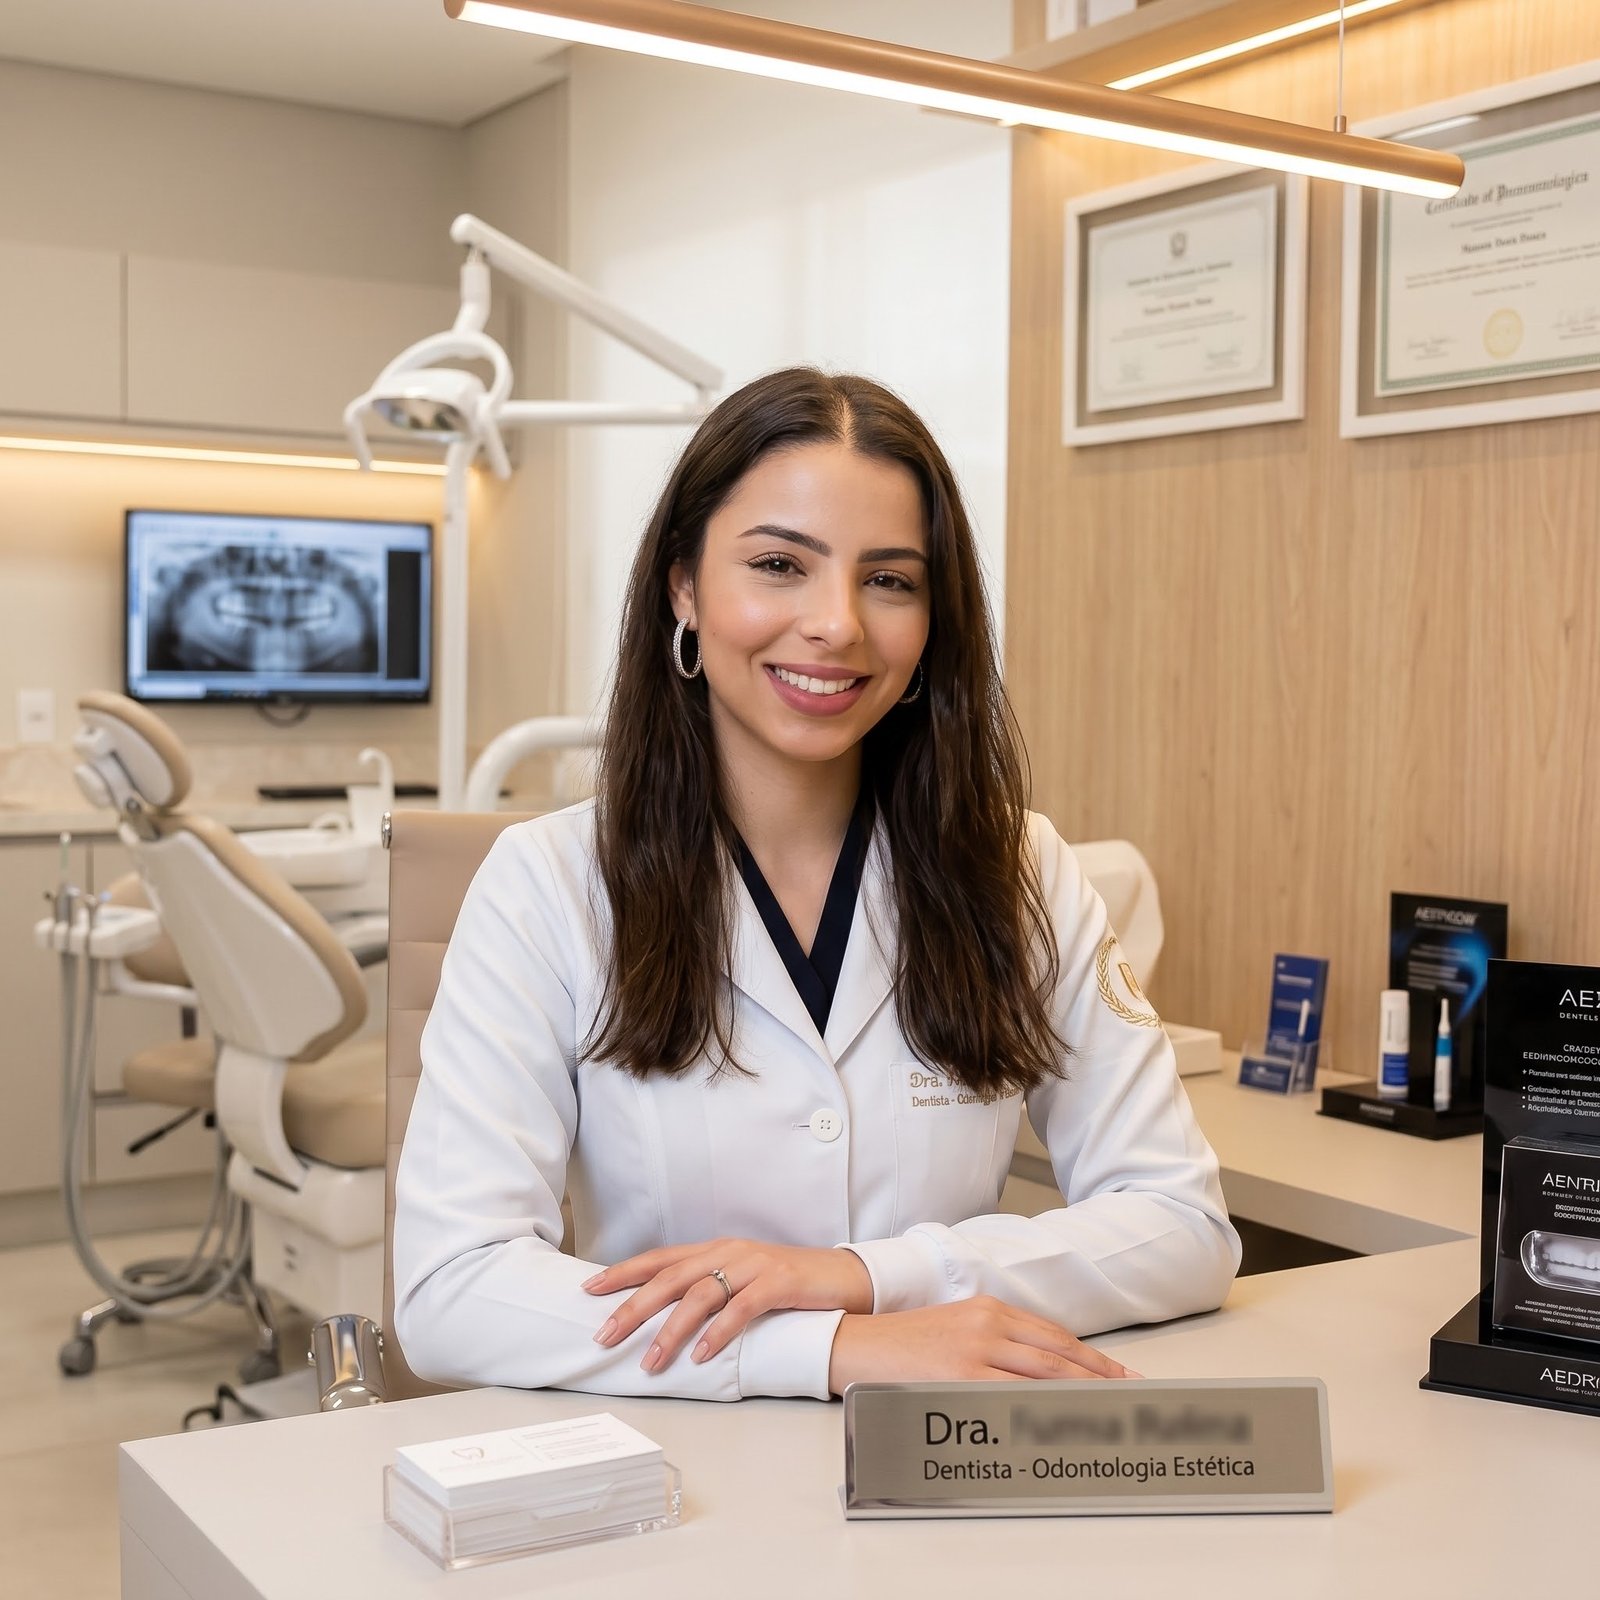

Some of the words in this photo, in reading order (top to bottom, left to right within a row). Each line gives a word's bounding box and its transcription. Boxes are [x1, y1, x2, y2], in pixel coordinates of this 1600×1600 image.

[910, 1072, 943, 1088] Dra.
[912, 1095, 950, 1107] Dentista
[925, 1411, 1000, 1445] Dra.
[923, 1459, 1012, 1480] Dentista
[1032, 1457, 1167, 1483] Odontologia
[1173, 1456, 1255, 1477] Estética
